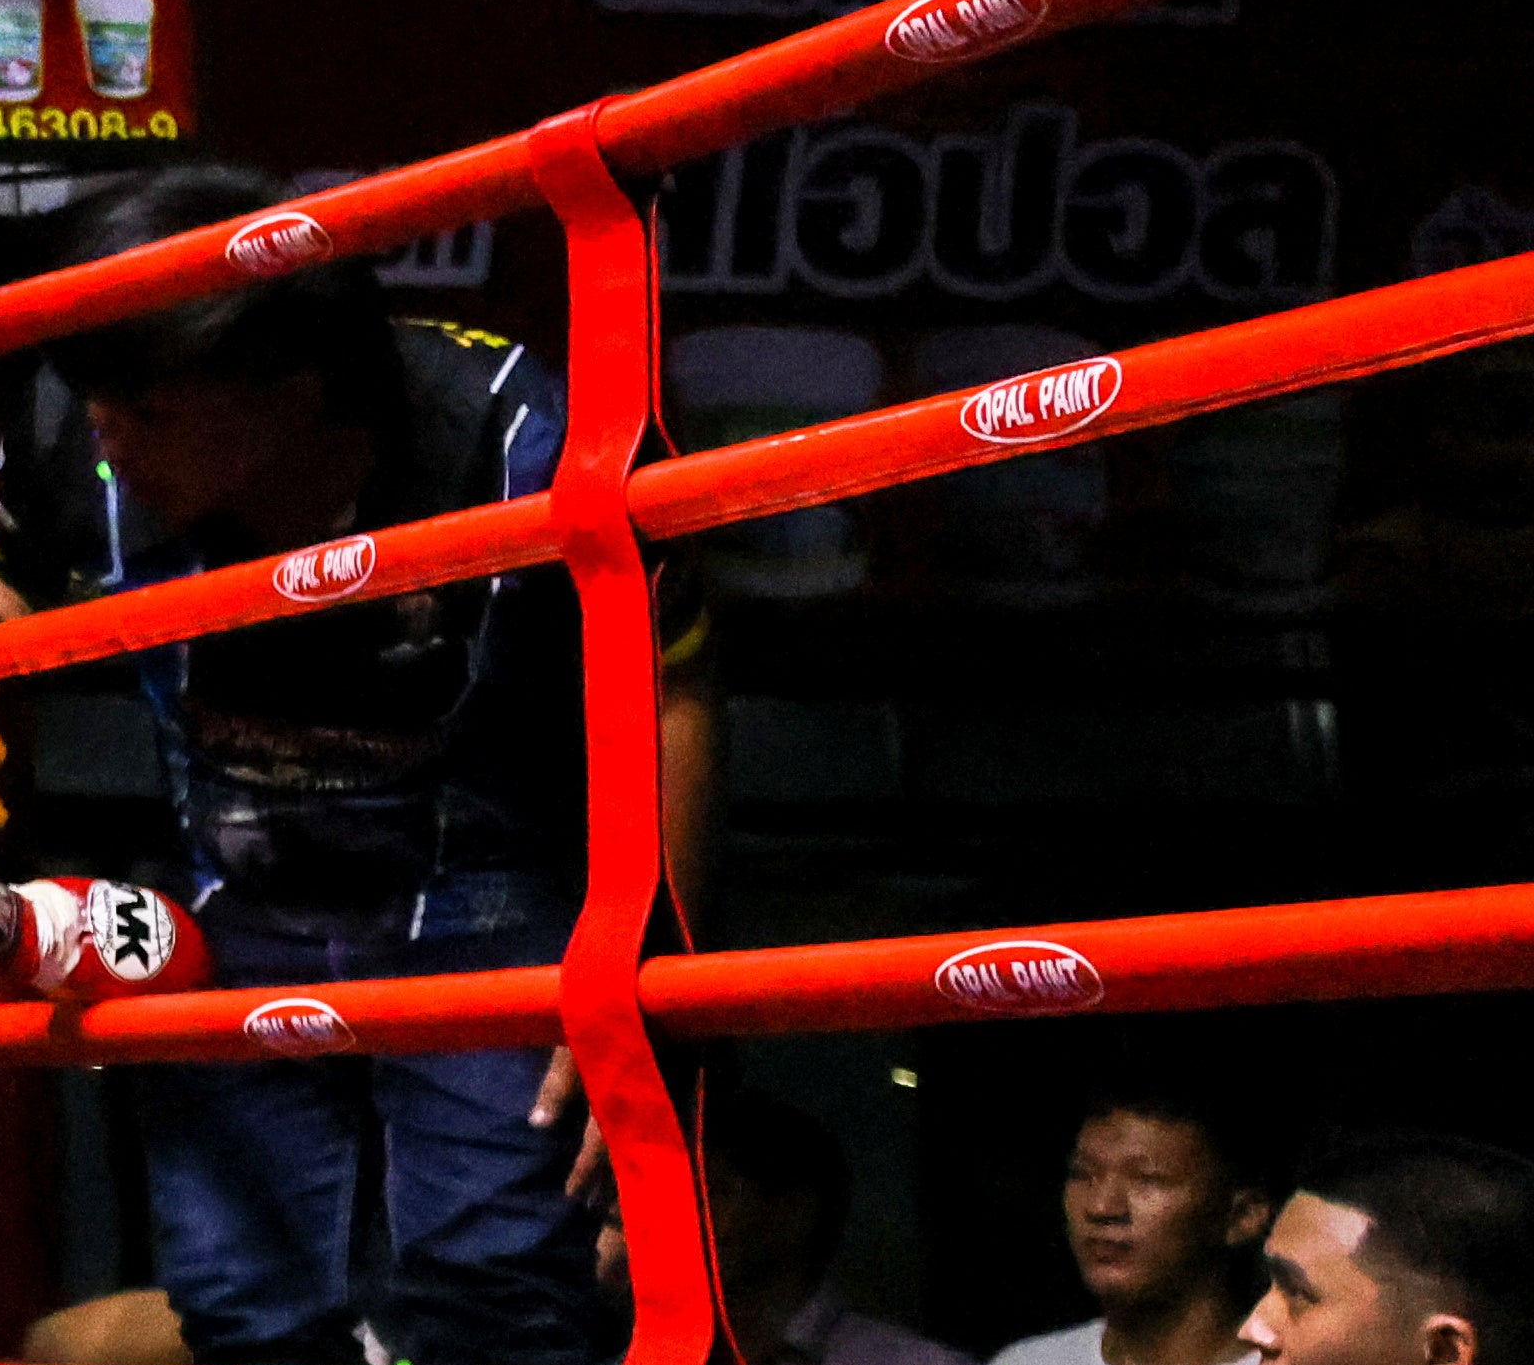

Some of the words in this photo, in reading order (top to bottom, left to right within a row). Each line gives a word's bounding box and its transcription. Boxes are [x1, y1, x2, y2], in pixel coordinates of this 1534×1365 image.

[898, 9, 967, 51] OPAL
[976, 384, 1034, 435] OPAL
[1039, 364, 1109, 419] PAINT
[282, 553, 320, 594] OPAL
[322, 542, 367, 584] PAINT
[947, 963, 1018, 1001] OPAL
[1010, 958, 1085, 1000] PAINT
